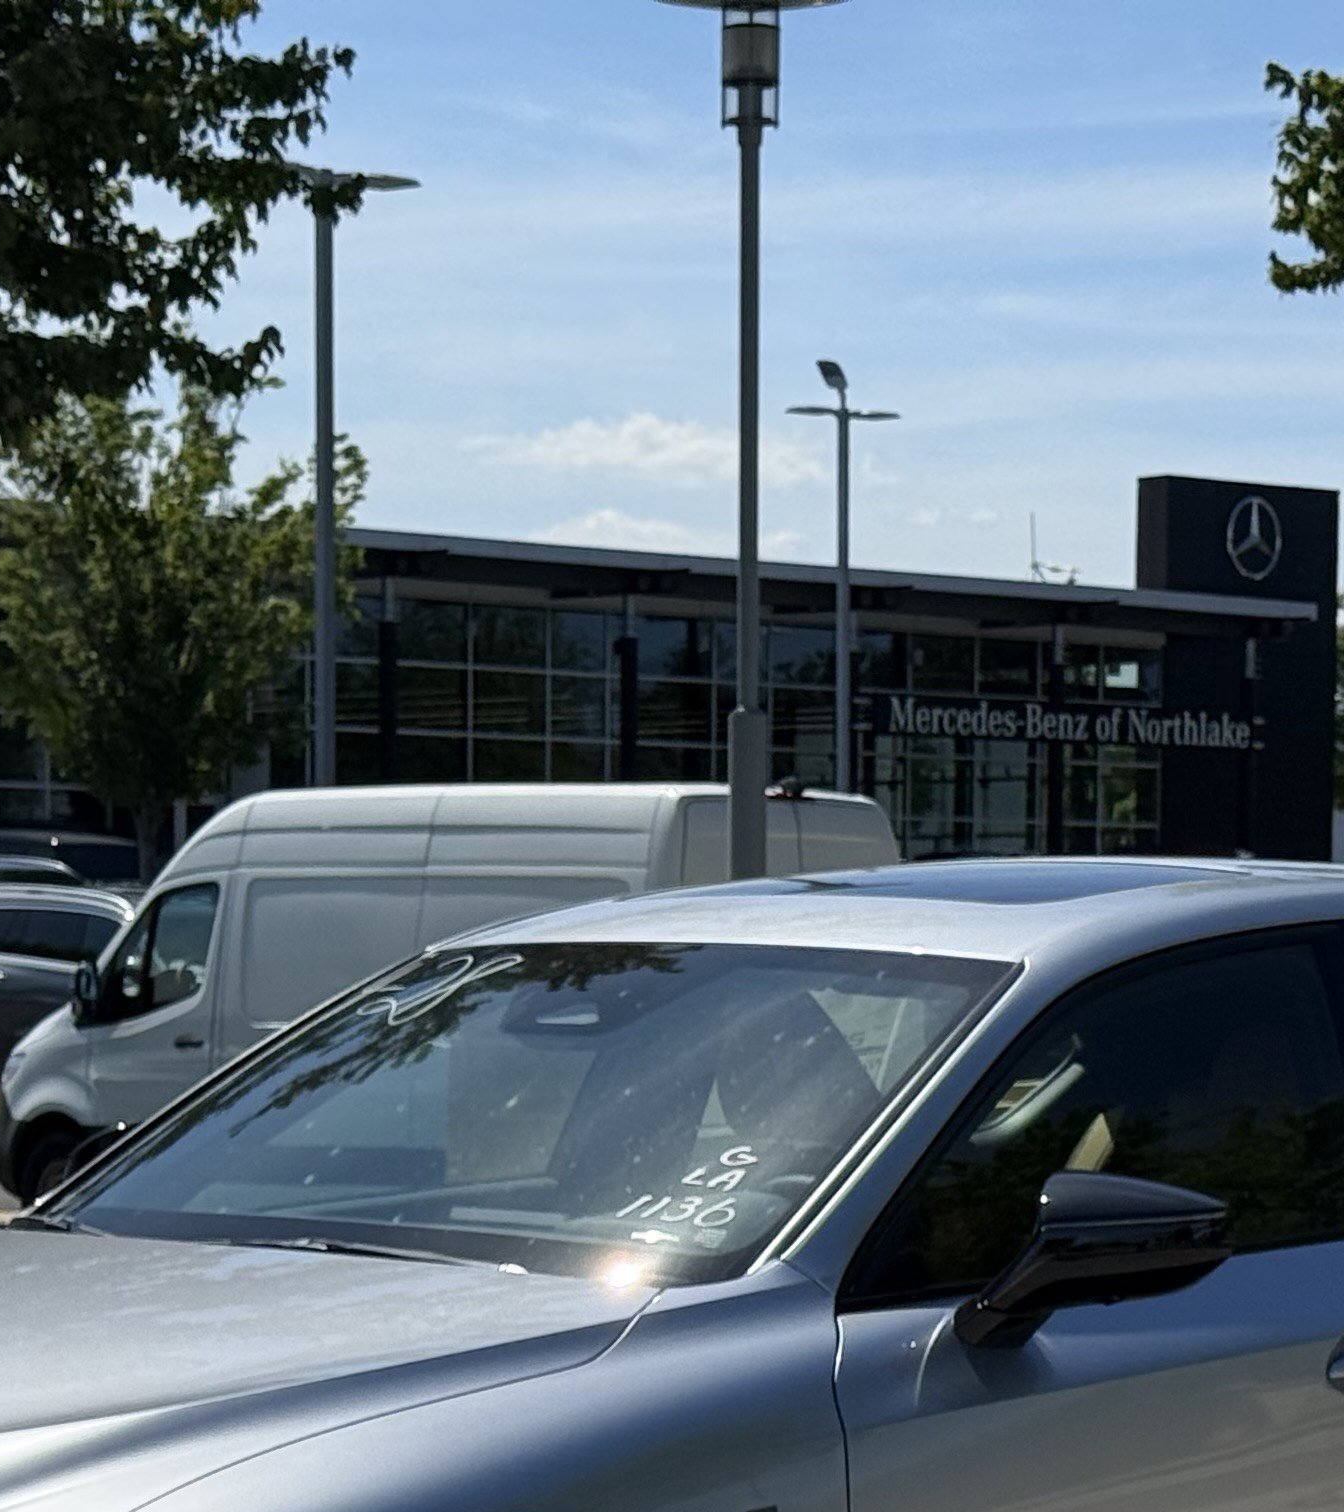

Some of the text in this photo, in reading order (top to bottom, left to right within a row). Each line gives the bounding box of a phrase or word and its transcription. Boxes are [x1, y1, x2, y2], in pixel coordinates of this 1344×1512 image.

[888, 697, 1251, 749] Mercedes-Benz of Northlake
[681, 1165, 747, 1192] LA
[615, 1194, 737, 1228] 1136
